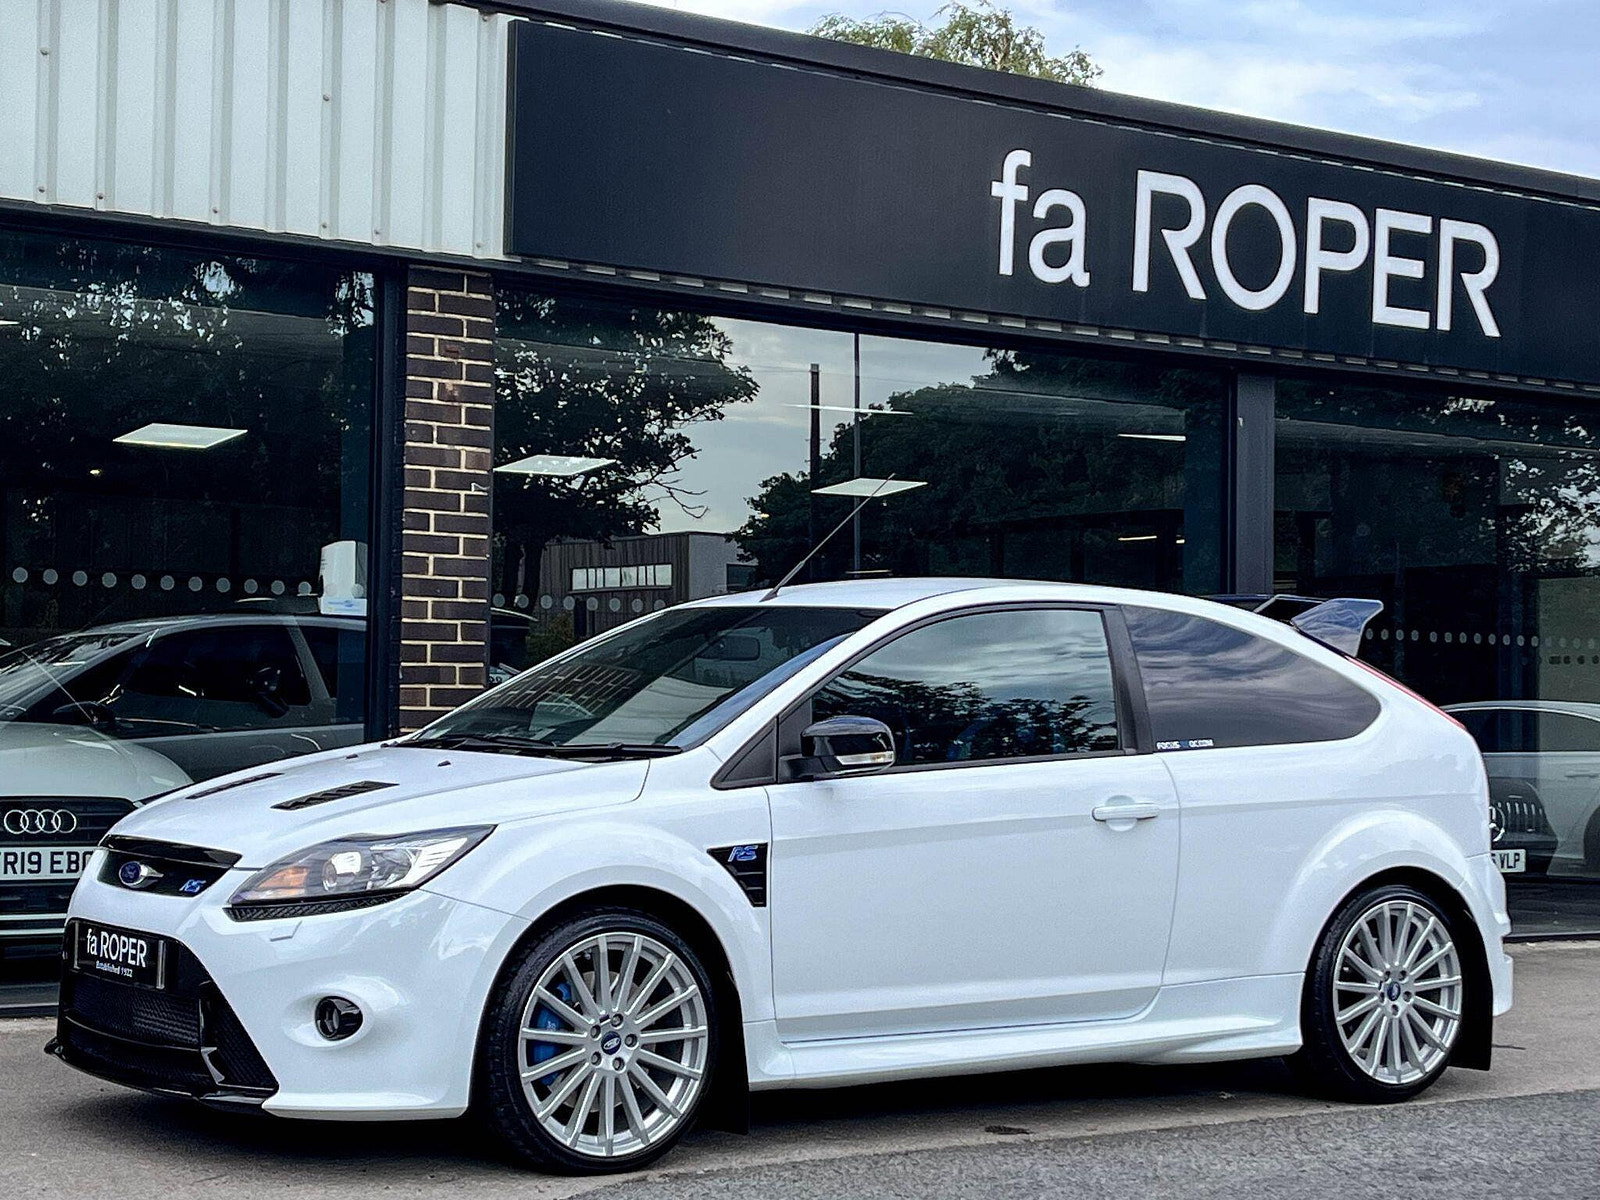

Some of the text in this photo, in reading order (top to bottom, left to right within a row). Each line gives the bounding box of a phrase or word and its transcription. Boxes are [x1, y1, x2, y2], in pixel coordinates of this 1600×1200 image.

[991, 149, 1501, 338] fa ROPER
[0, 852, 42, 874] R19
[728, 845, 758, 862] RS
[87, 928, 147, 968] fa ROPER
